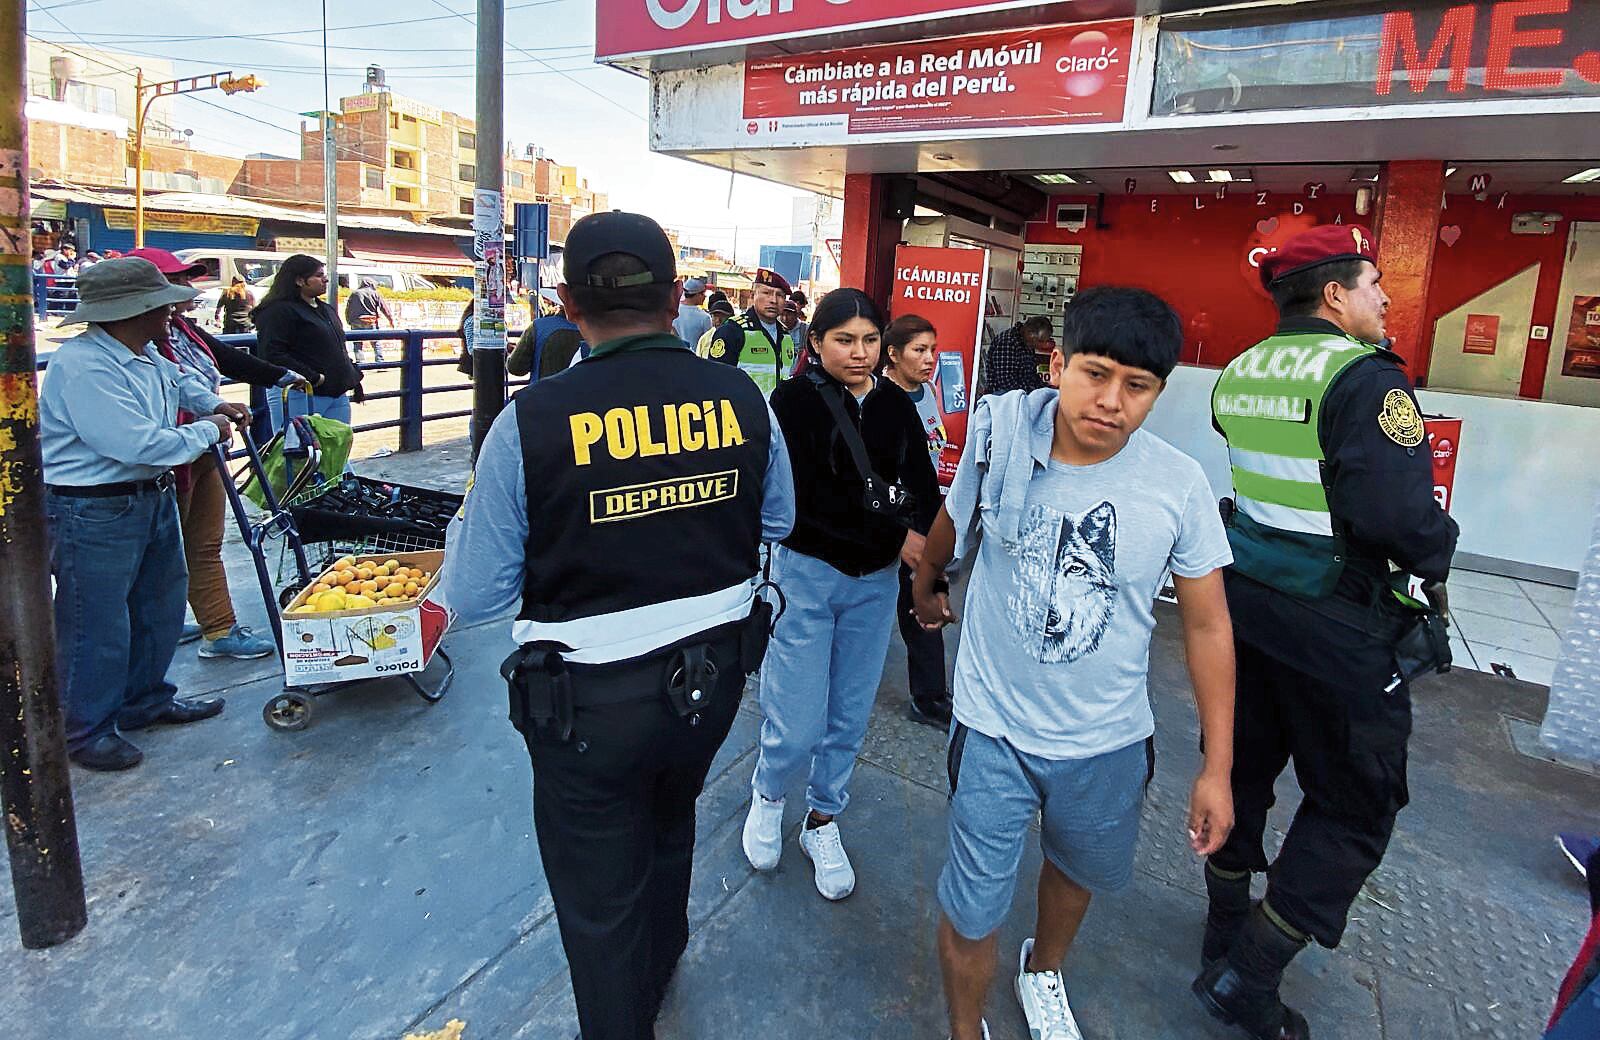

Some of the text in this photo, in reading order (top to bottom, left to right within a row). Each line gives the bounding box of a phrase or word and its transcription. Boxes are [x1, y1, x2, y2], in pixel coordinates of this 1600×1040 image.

[784, 41, 1042, 84] Cámbiate a la Red Móvil
[1055, 55, 1109, 72] Claro
[799, 71, 1016, 105] más rápida del Perú.
[897, 265, 980, 287] ¡CÁMBIATE
[903, 285, 971, 304] A CLARO!
[952, 383, 967, 409] S24
[1433, 449, 1450, 458] Claro
[605, 477, 727, 515] DEPROVE
